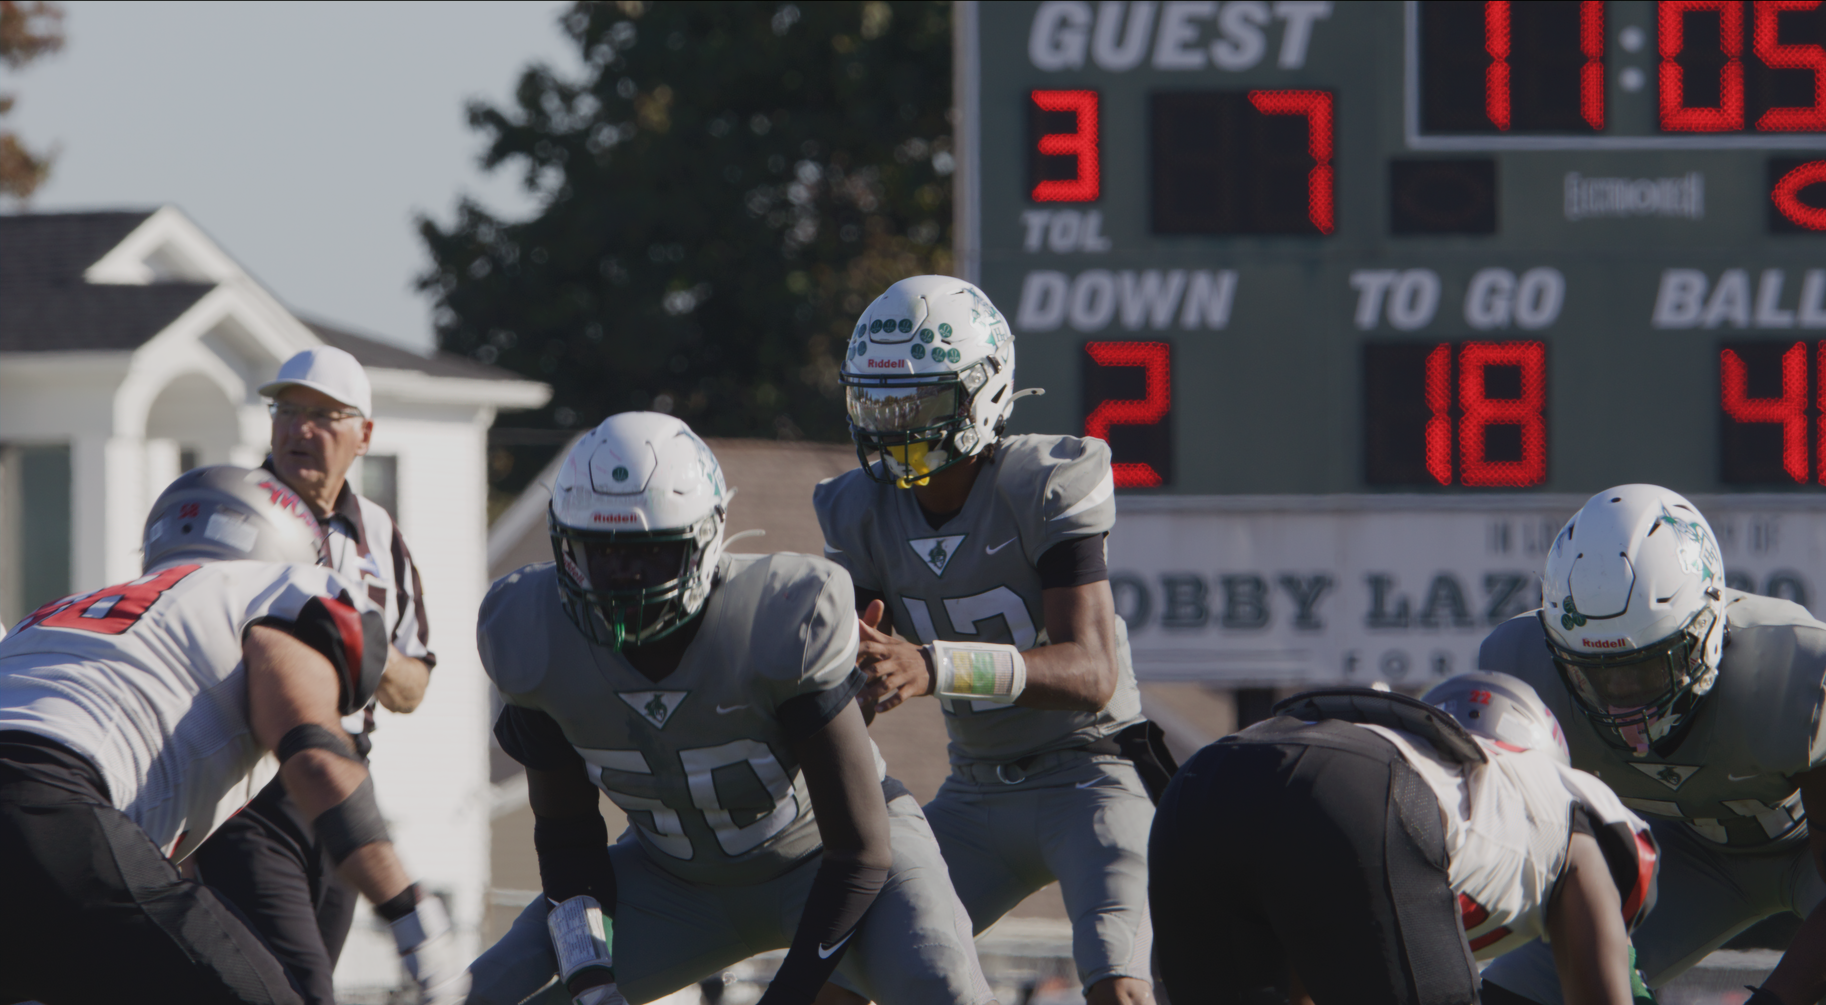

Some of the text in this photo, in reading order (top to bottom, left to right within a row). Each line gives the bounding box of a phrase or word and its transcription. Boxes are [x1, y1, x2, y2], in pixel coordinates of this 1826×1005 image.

[1028, 1, 1334, 71] GUEST
[1031, 90, 1099, 202] 3
[1248, 90, 1334, 235] 7
[1021, 209, 1111, 253] TOL
[1016, 269, 1238, 331] DOWN
[1349, 267, 1566, 330] TO GO
[1651, 268, 1826, 329] BALL
[868, 359, 905, 369] Riddell
[1084, 342, 1171, 488] 2
[1425, 341, 1547, 488] 18
[593, 513, 638, 524] Riddell
[1112, 571, 1335, 631] OBBY
[1582, 638, 1626, 649] Riddell
[1469, 689, 1492, 705] 22
[572, 738, 799, 861] 50
